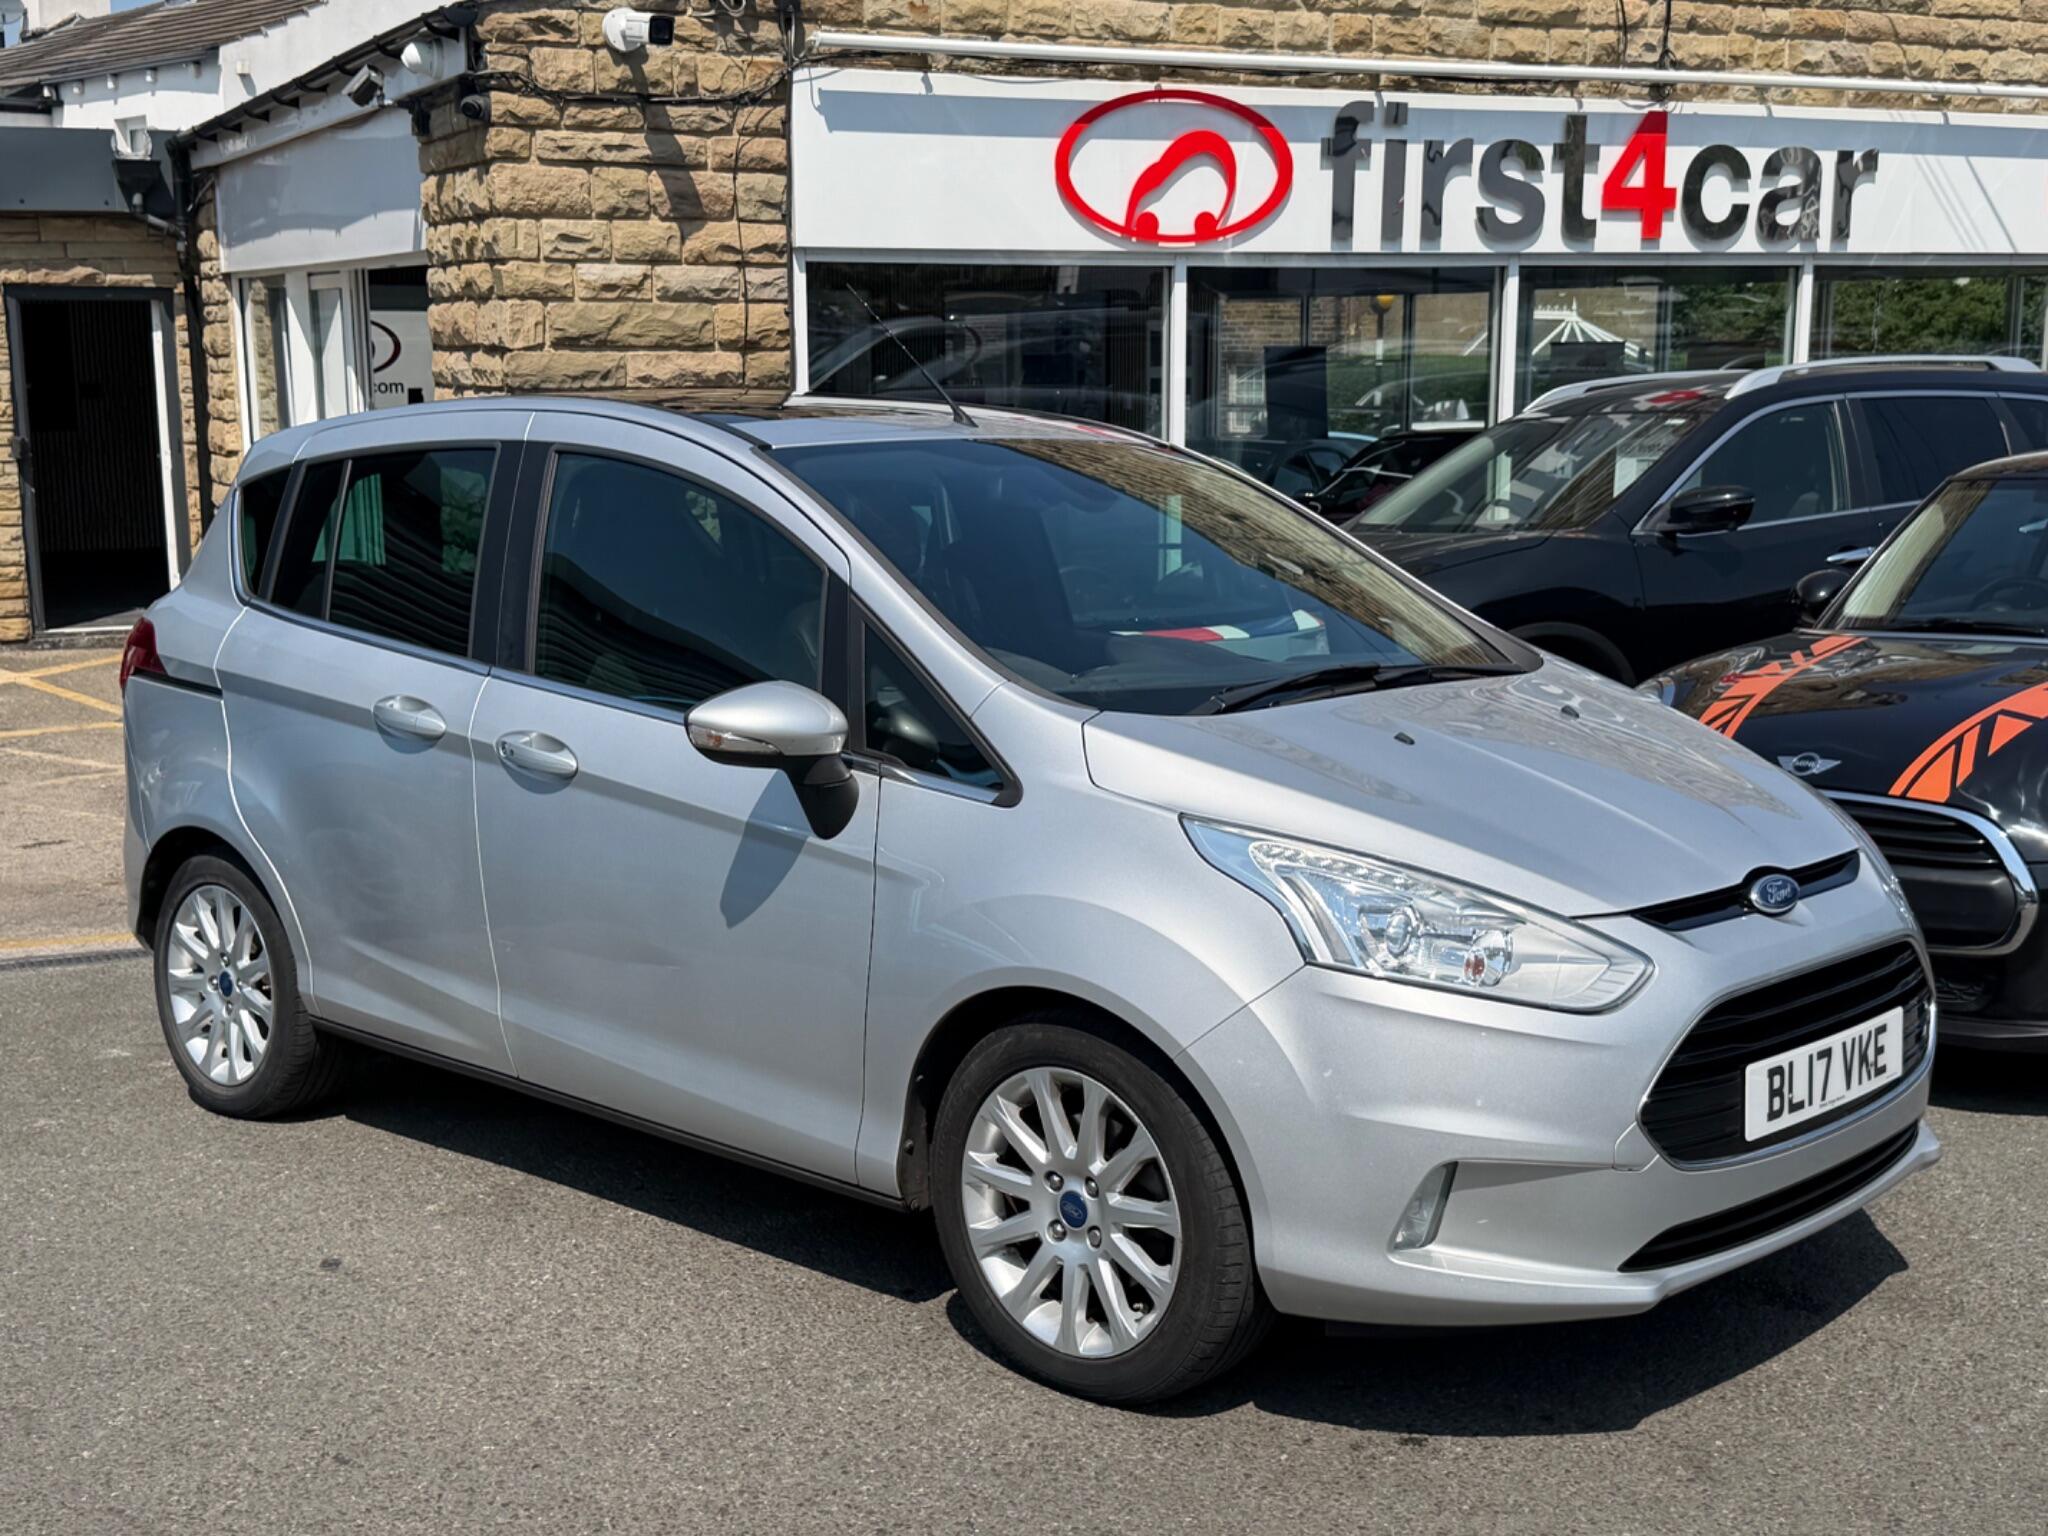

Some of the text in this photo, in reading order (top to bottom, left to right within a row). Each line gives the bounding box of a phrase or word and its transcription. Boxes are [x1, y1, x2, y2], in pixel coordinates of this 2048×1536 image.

[1321, 101, 1880, 242] first4car
[1766, 880, 1792, 904] Ford
[1766, 1023, 1888, 1122] BL17 VKE
